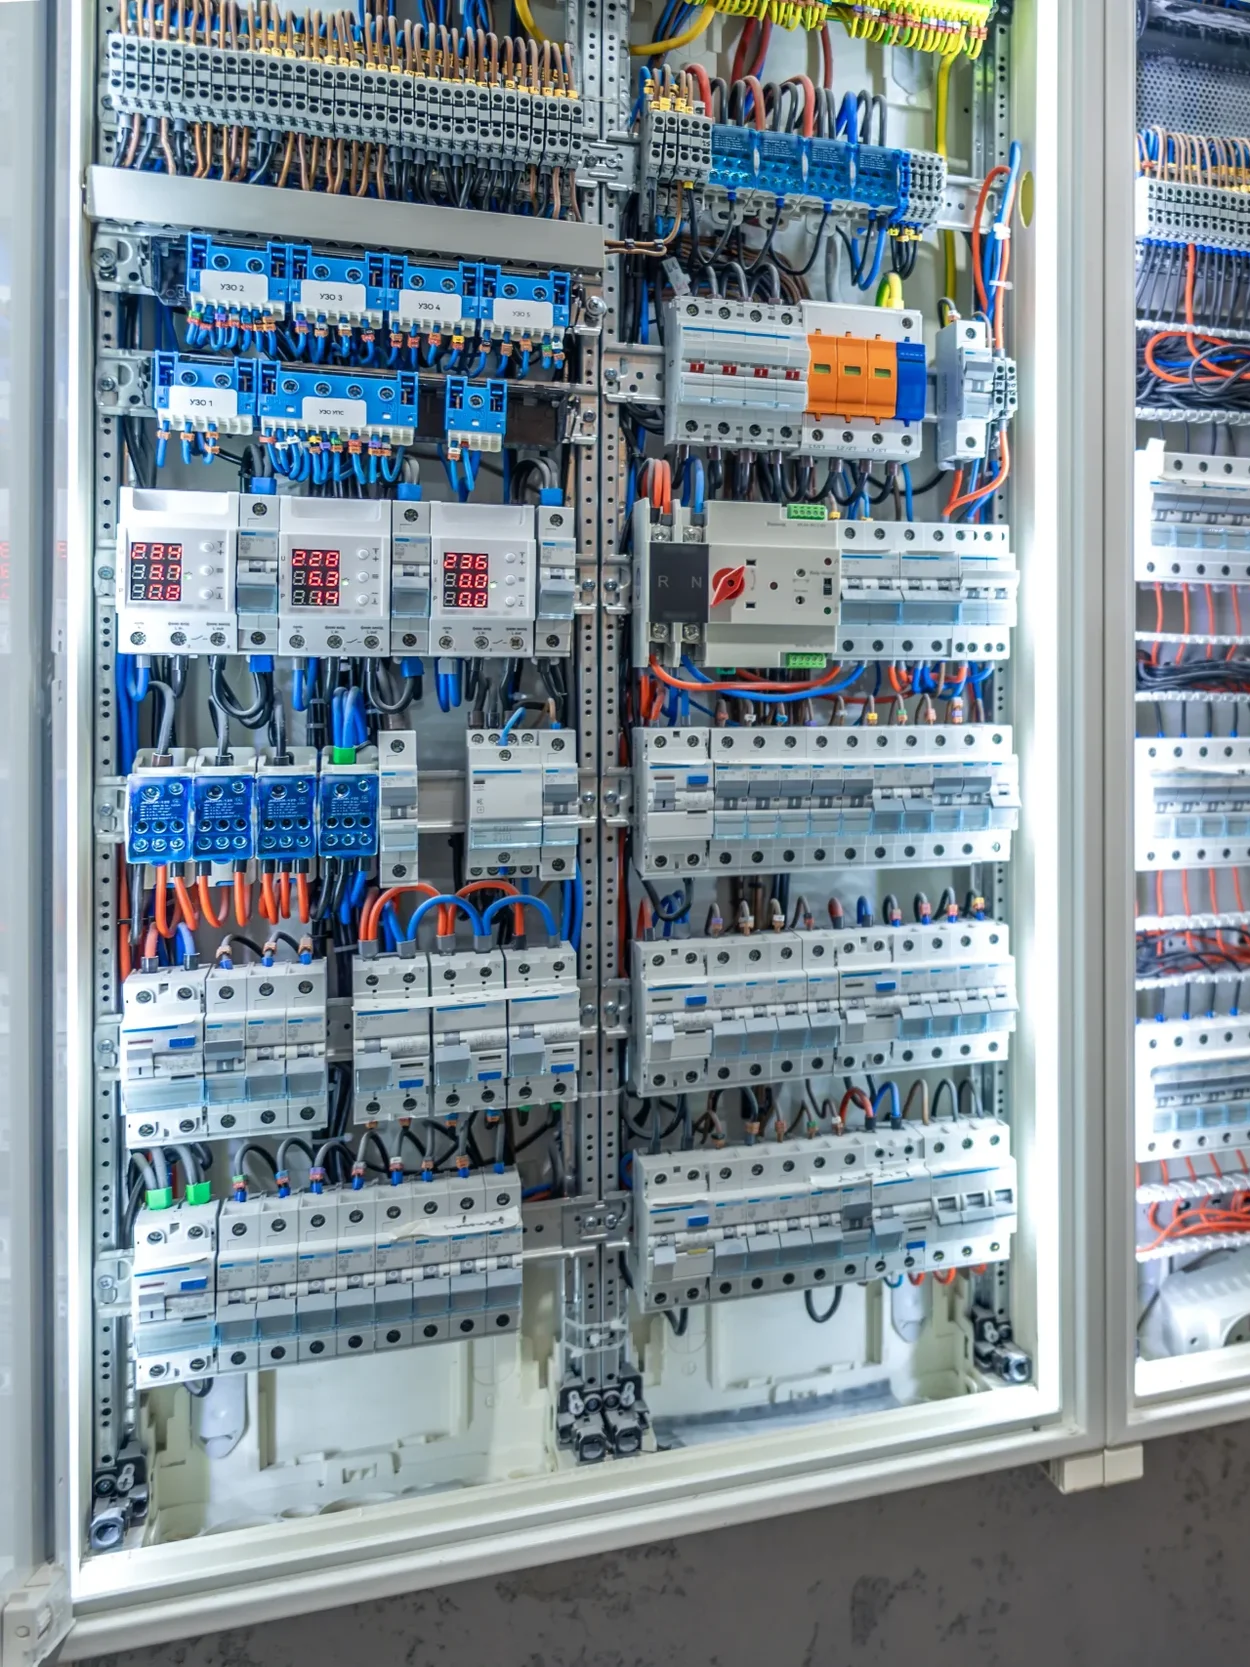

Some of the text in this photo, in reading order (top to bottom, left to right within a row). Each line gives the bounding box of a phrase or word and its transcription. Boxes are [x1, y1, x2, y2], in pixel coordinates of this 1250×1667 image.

[239, 284, 245, 292] 2
[435, 303, 441, 311] 4
[292, 550, 339, 567] 228
[444, 554, 487, 570] 236
[658, 575, 702, 588] R N
